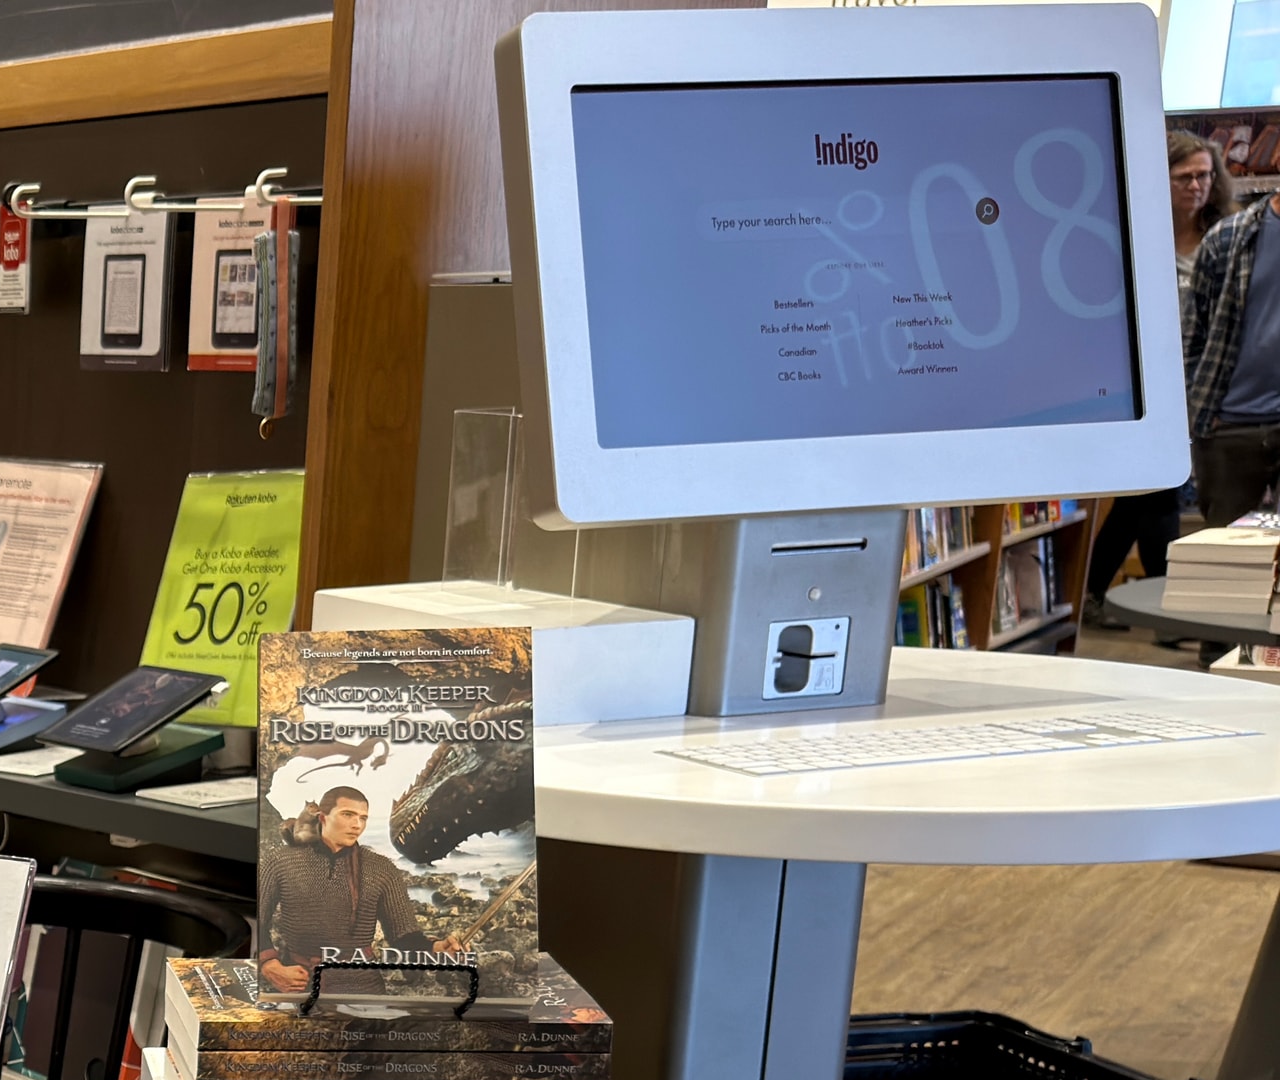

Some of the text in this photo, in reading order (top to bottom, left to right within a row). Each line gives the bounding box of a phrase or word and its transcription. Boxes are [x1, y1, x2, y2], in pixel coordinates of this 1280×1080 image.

[712, 213, 832, 230] Type your search here...
[893, 292, 952, 304] New This Week
[774, 299, 814, 310] Bestsellers
[760, 322, 831, 334] Picks of the Month
[896, 317, 952, 328] Heather's Picks
[908, 340, 944, 351] #Booktok
[778, 348, 817, 357] Canadian
[778, 370, 821, 381] CBC Books
[898, 364, 958, 375] Award Winners
[195, 549, 209, 561] Buy
[211, 551, 218, 559] a
[220, 549, 241, 559] Kobo
[182, 562, 286, 576] Get One Kobo Accessory
[173, 581, 269, 646] 50%
[237, 621, 263, 646] off
[301, 646, 493, 660] Because legends are not born in comfort.
[297, 685, 496, 706] KINGDOM KEEPER
[270, 719, 526, 745] RISE OF THE DRAGONS
